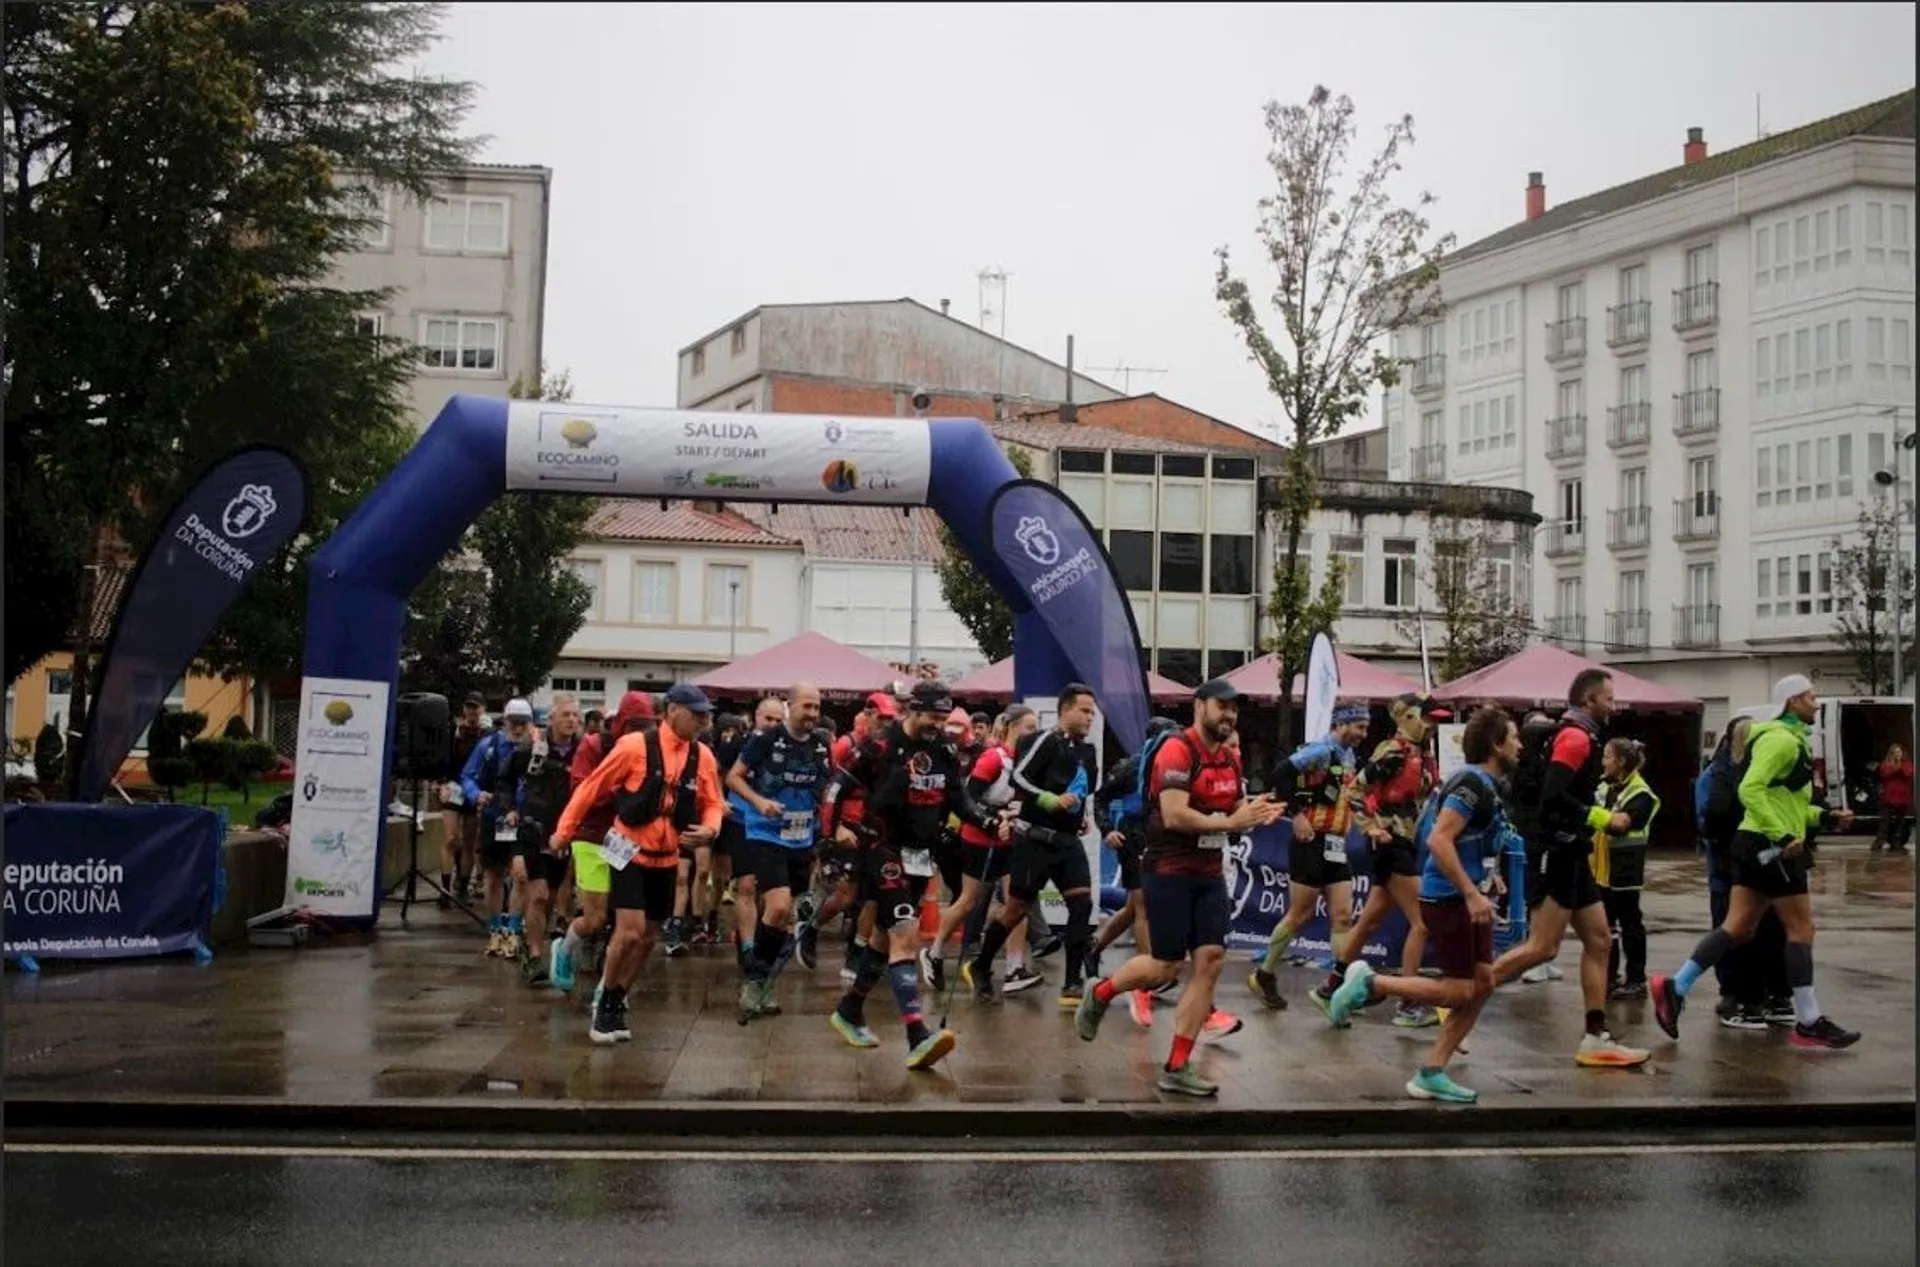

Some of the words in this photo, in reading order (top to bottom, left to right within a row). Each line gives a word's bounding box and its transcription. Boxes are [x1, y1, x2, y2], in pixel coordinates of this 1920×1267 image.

[684, 421, 758, 439] SALIDA
[676, 445, 710, 457] START
[175, 526, 195, 546] DA
[185, 513, 254, 570] Deputación
[3, 857, 124, 891] eputación
[3, 889, 17, 915] A
[24, 884, 121, 914] CORUÑA
[1259, 890, 1285, 914] DA
